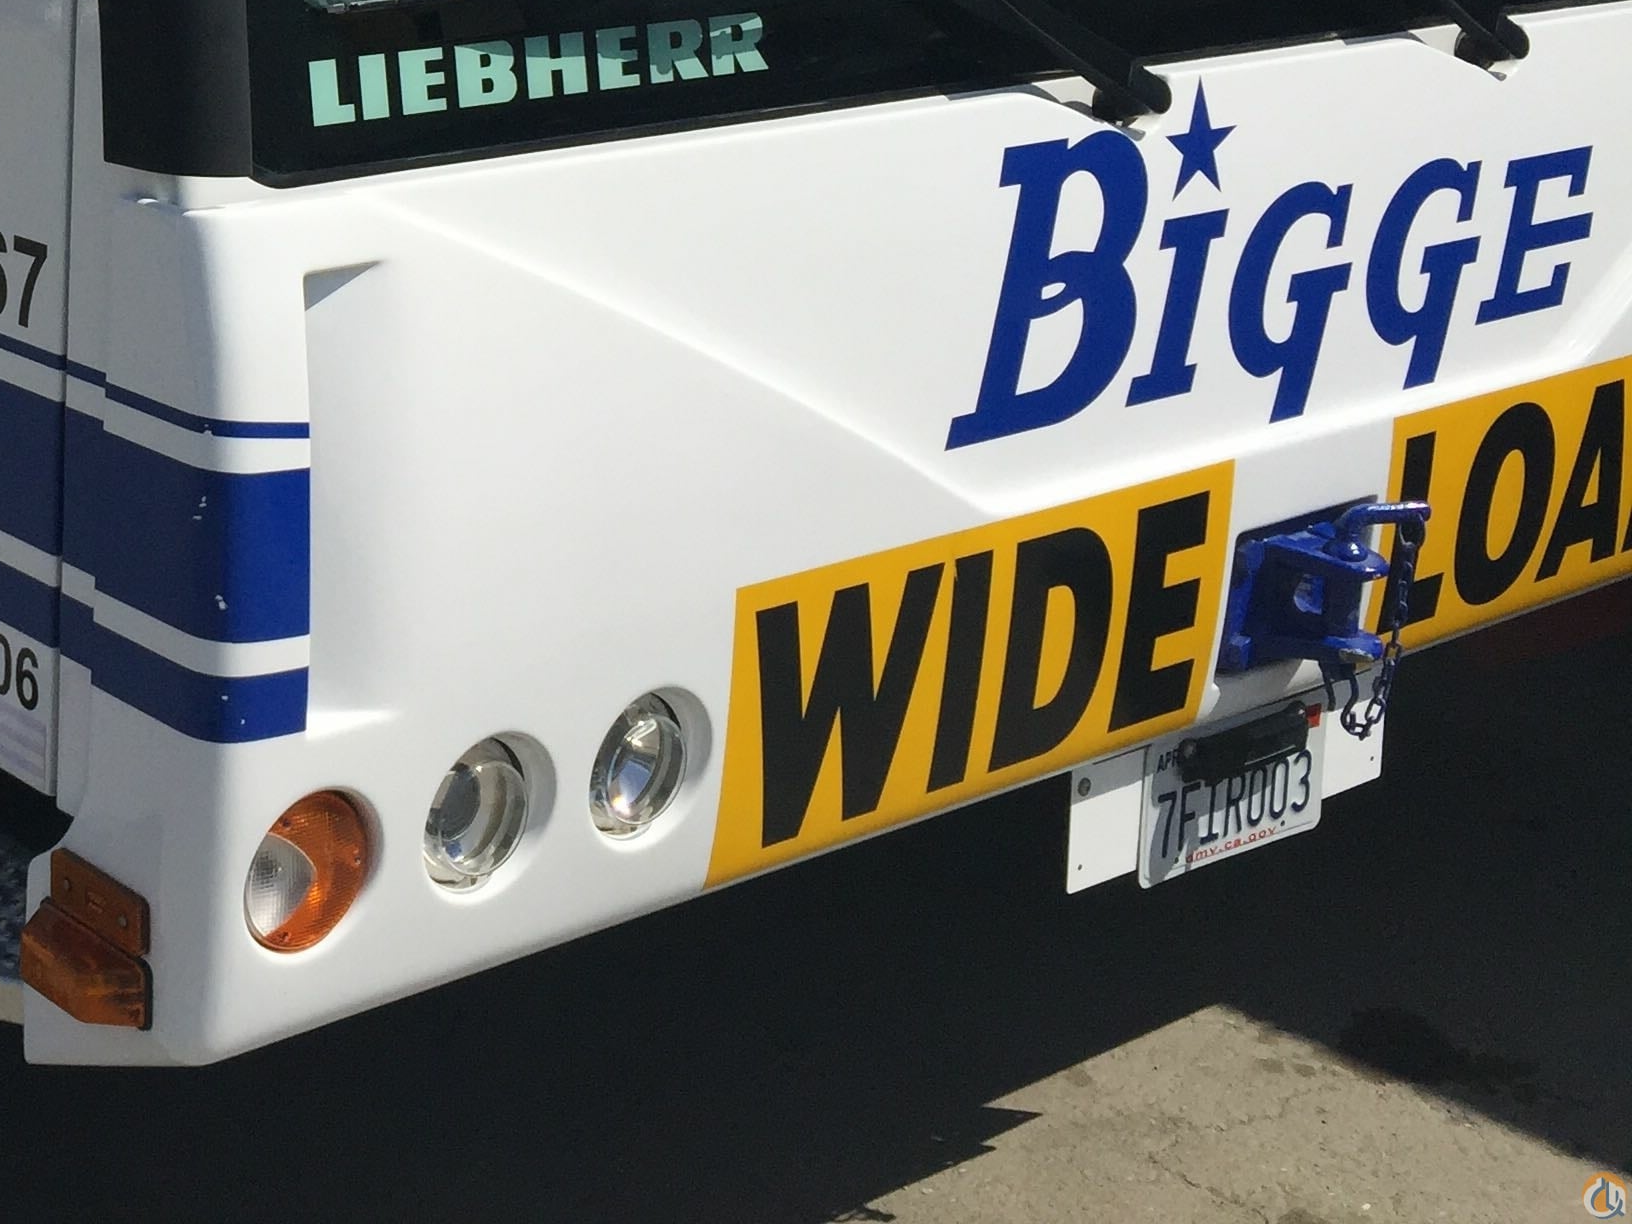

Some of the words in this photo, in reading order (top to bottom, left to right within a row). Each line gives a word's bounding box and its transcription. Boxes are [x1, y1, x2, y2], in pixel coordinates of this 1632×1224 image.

[307, 12, 770, 127] LIEBHERR
[756, 489, 1212, 848] WIDE
[1376, 377, 1632, 634] LOA
[1185, 826, 1276, 864] dmv.ca.gov
